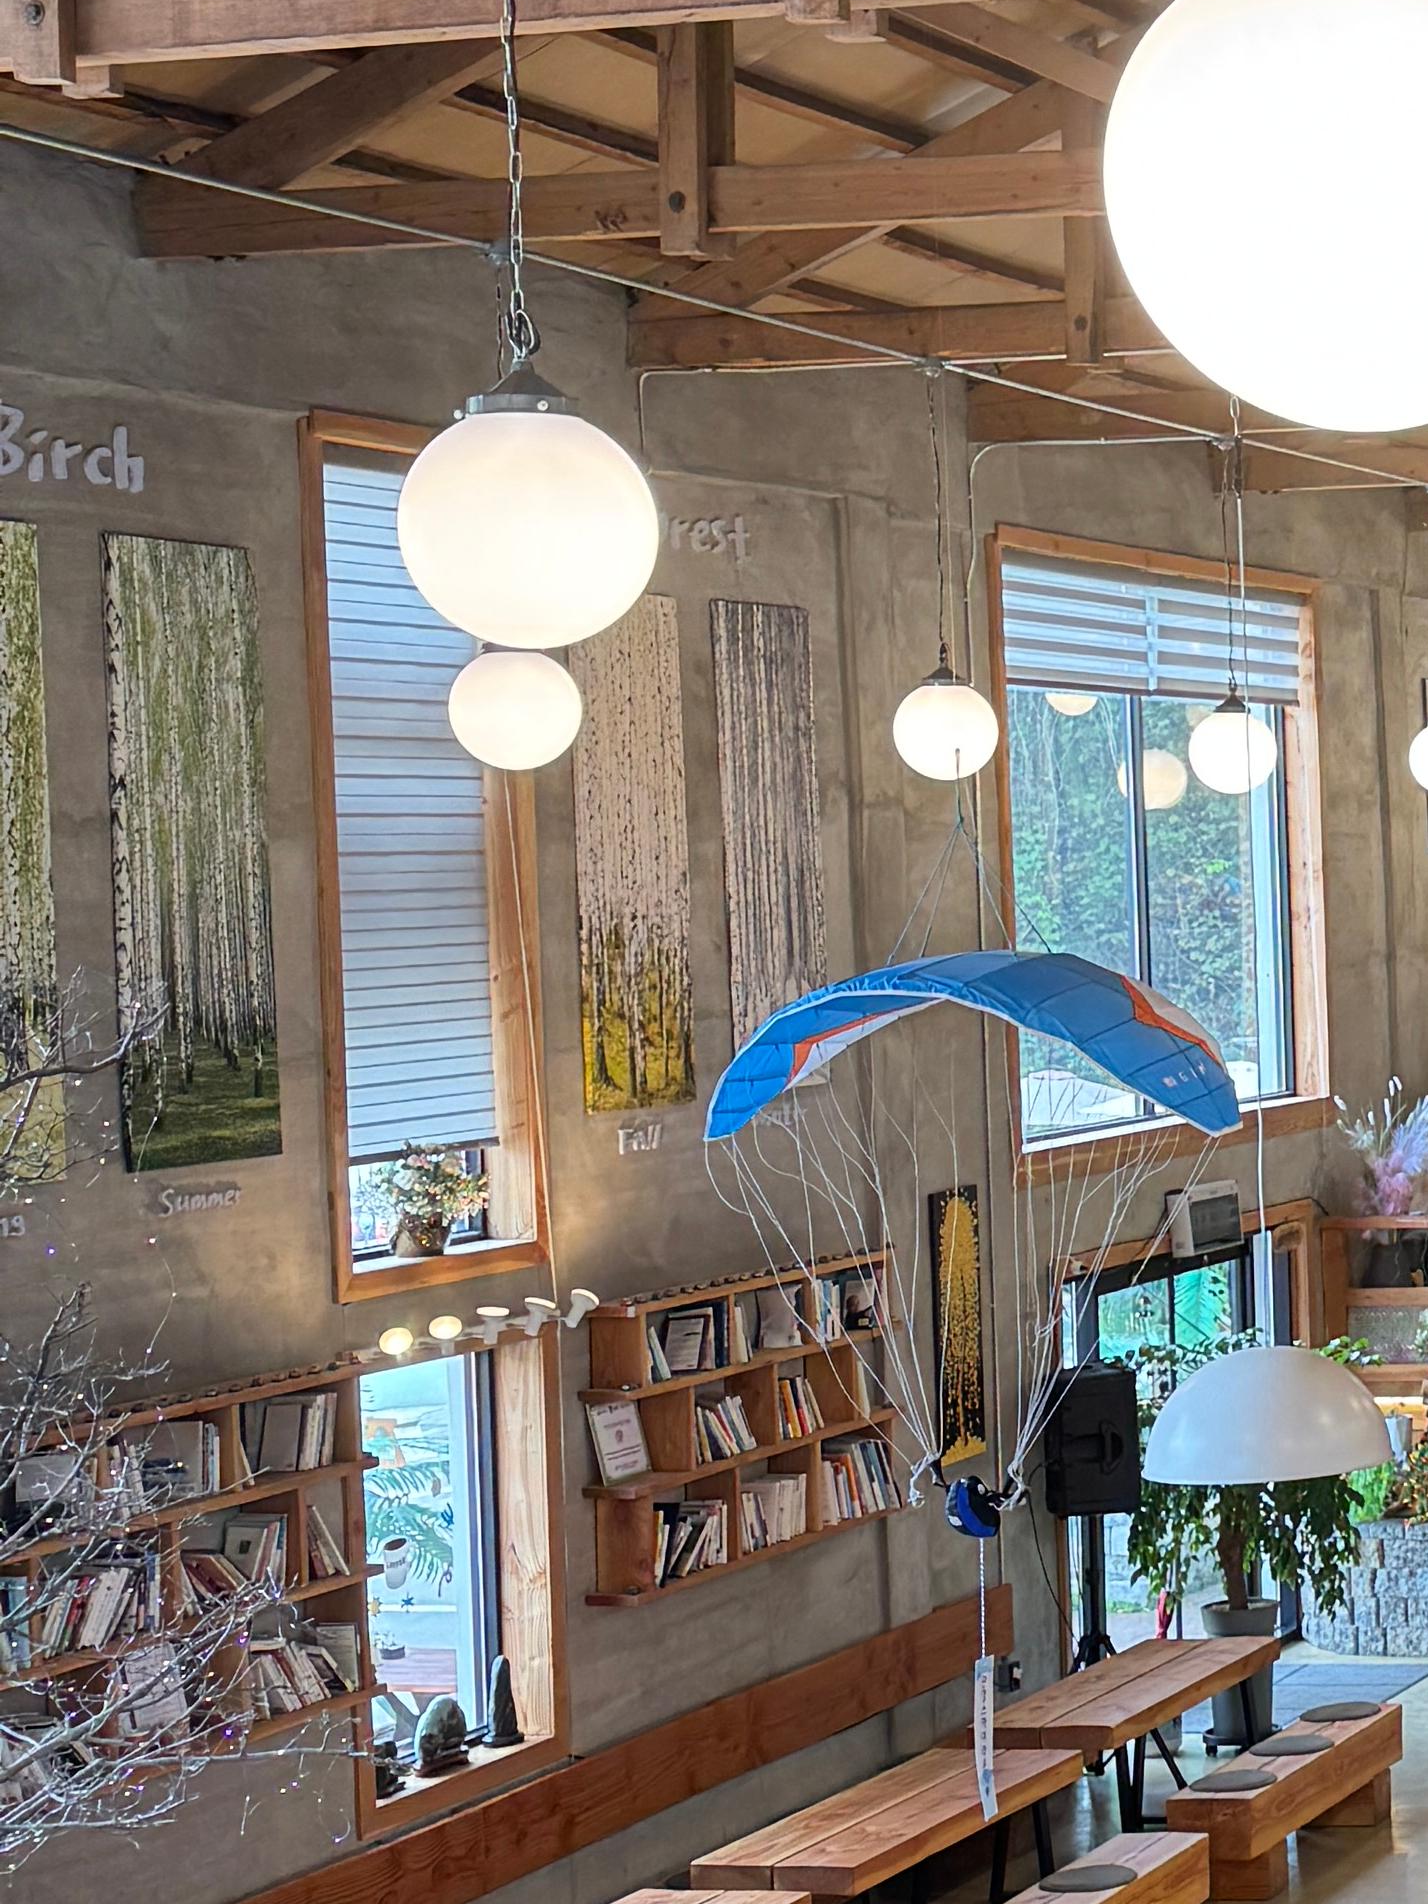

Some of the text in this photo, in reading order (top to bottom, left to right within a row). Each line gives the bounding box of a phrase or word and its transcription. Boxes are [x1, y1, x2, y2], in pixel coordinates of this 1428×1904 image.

[0, 403, 145, 493] Birch
[660, 512, 751, 562] rest
[617, 1124, 662, 1155] Fall
[158, 1189, 242, 1218] Summer
